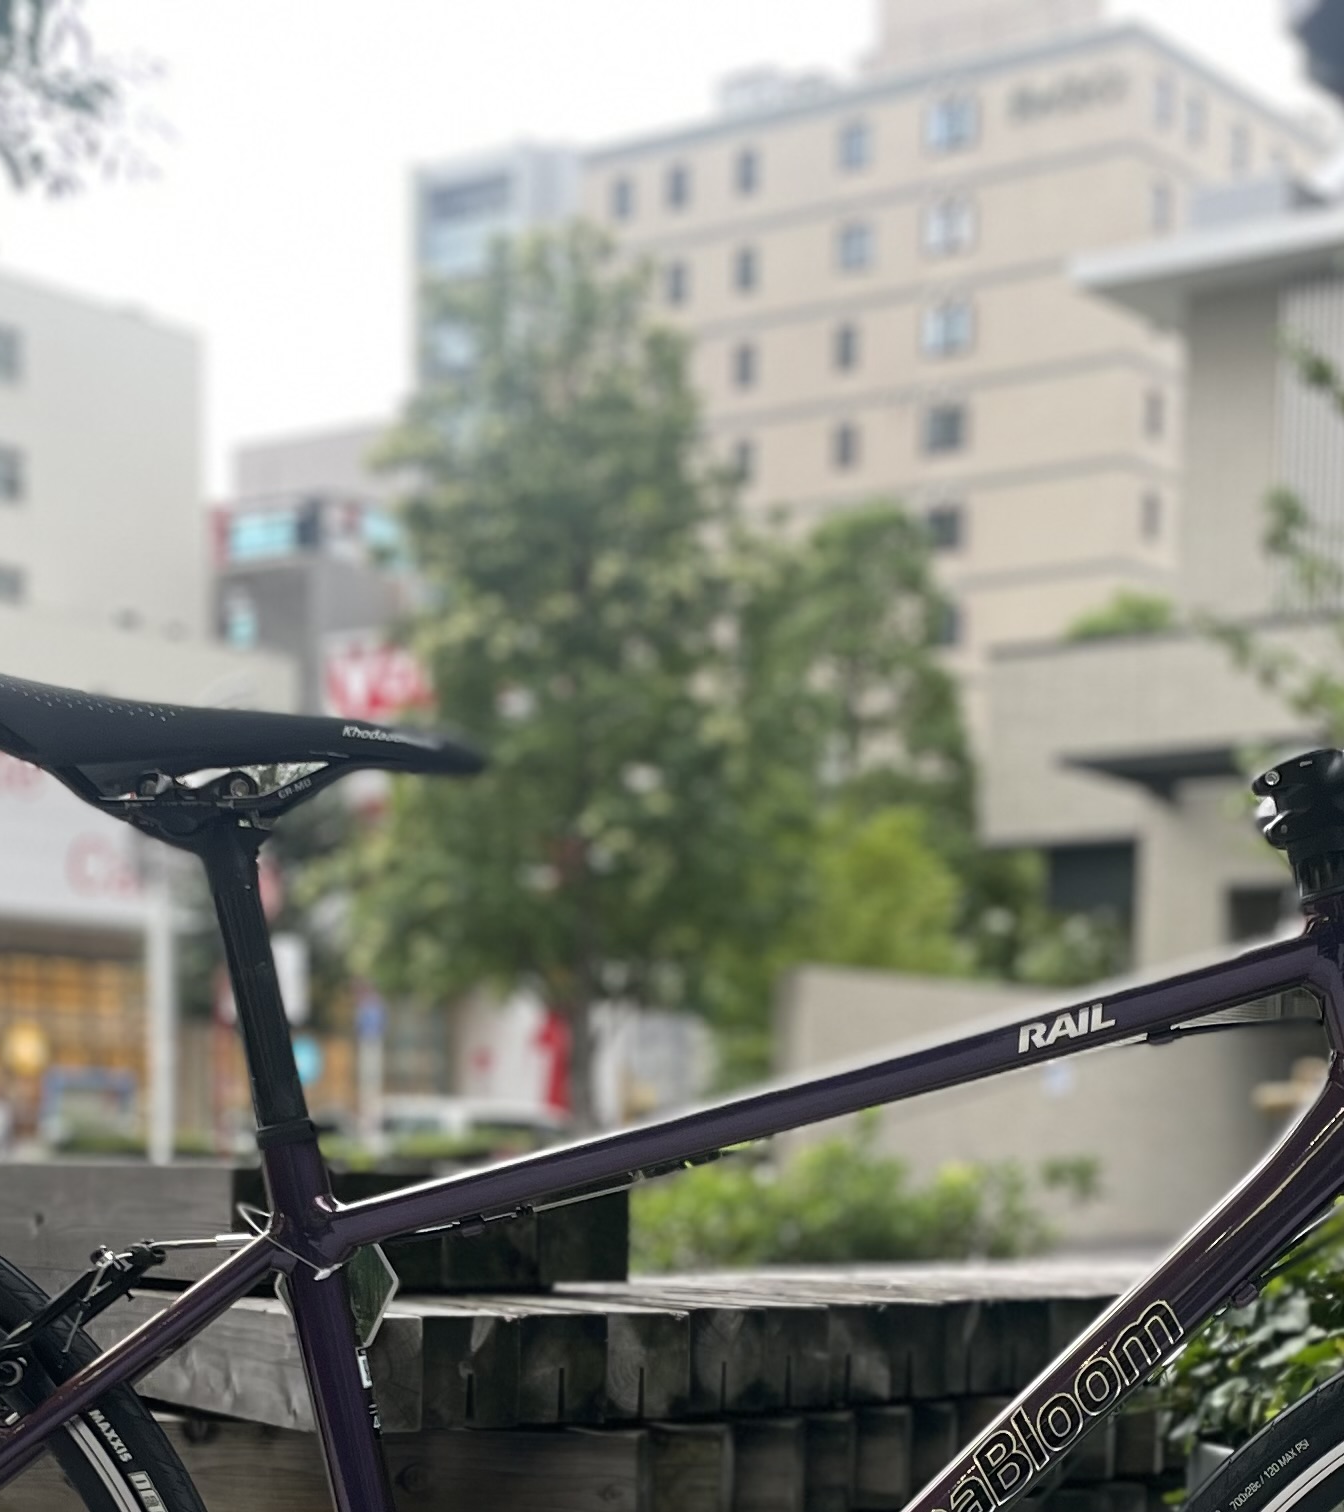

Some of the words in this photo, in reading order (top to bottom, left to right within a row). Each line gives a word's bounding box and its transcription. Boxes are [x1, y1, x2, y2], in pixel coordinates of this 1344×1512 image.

[1018, 1003, 1116, 1053] RAIL
[88, 1409, 132, 1463] MAXXIS
[1263, 1462, 1280, 1478] 120
[1277, 1447, 1297, 1467] MAX
[1295, 1438, 1309, 1453] PSI
